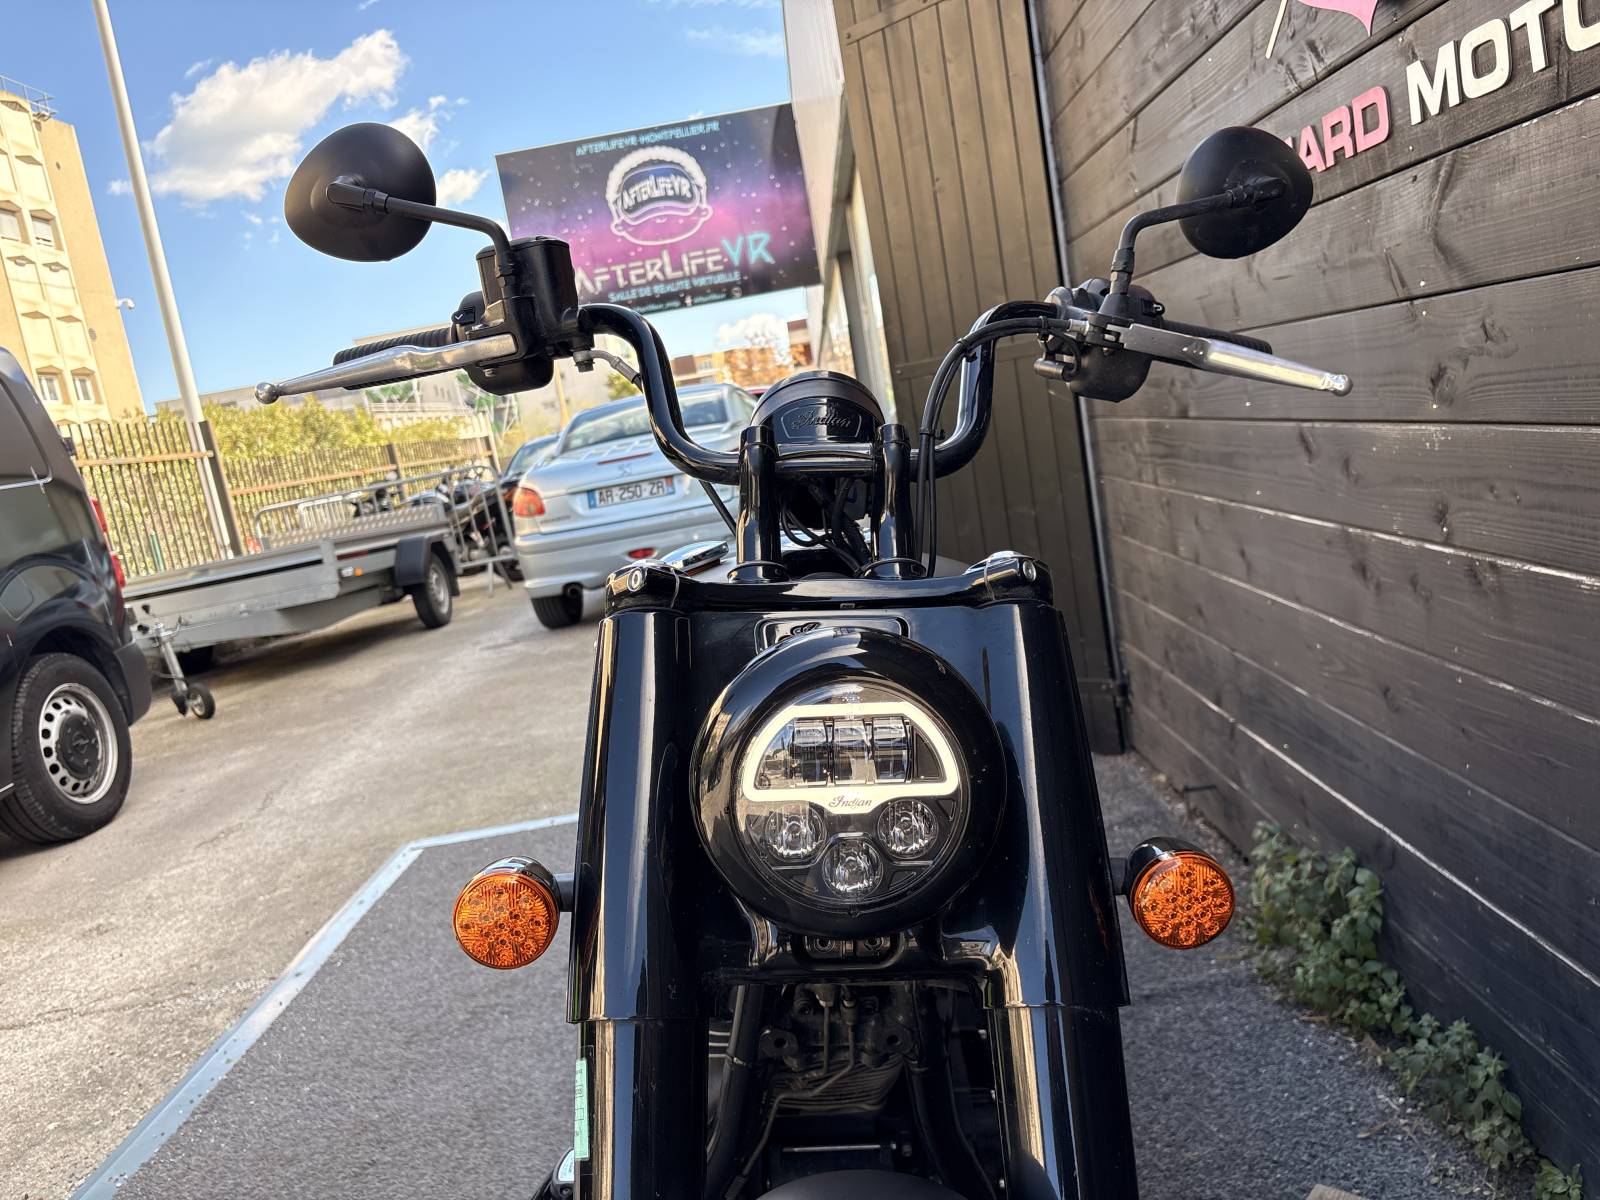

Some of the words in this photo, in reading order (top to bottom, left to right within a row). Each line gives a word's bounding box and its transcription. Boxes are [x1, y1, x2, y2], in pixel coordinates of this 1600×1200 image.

[1285, 86, 1389, 173] ARD
[791, 405, 851, 430] Indian
[829, 795, 872, 809] Indian
